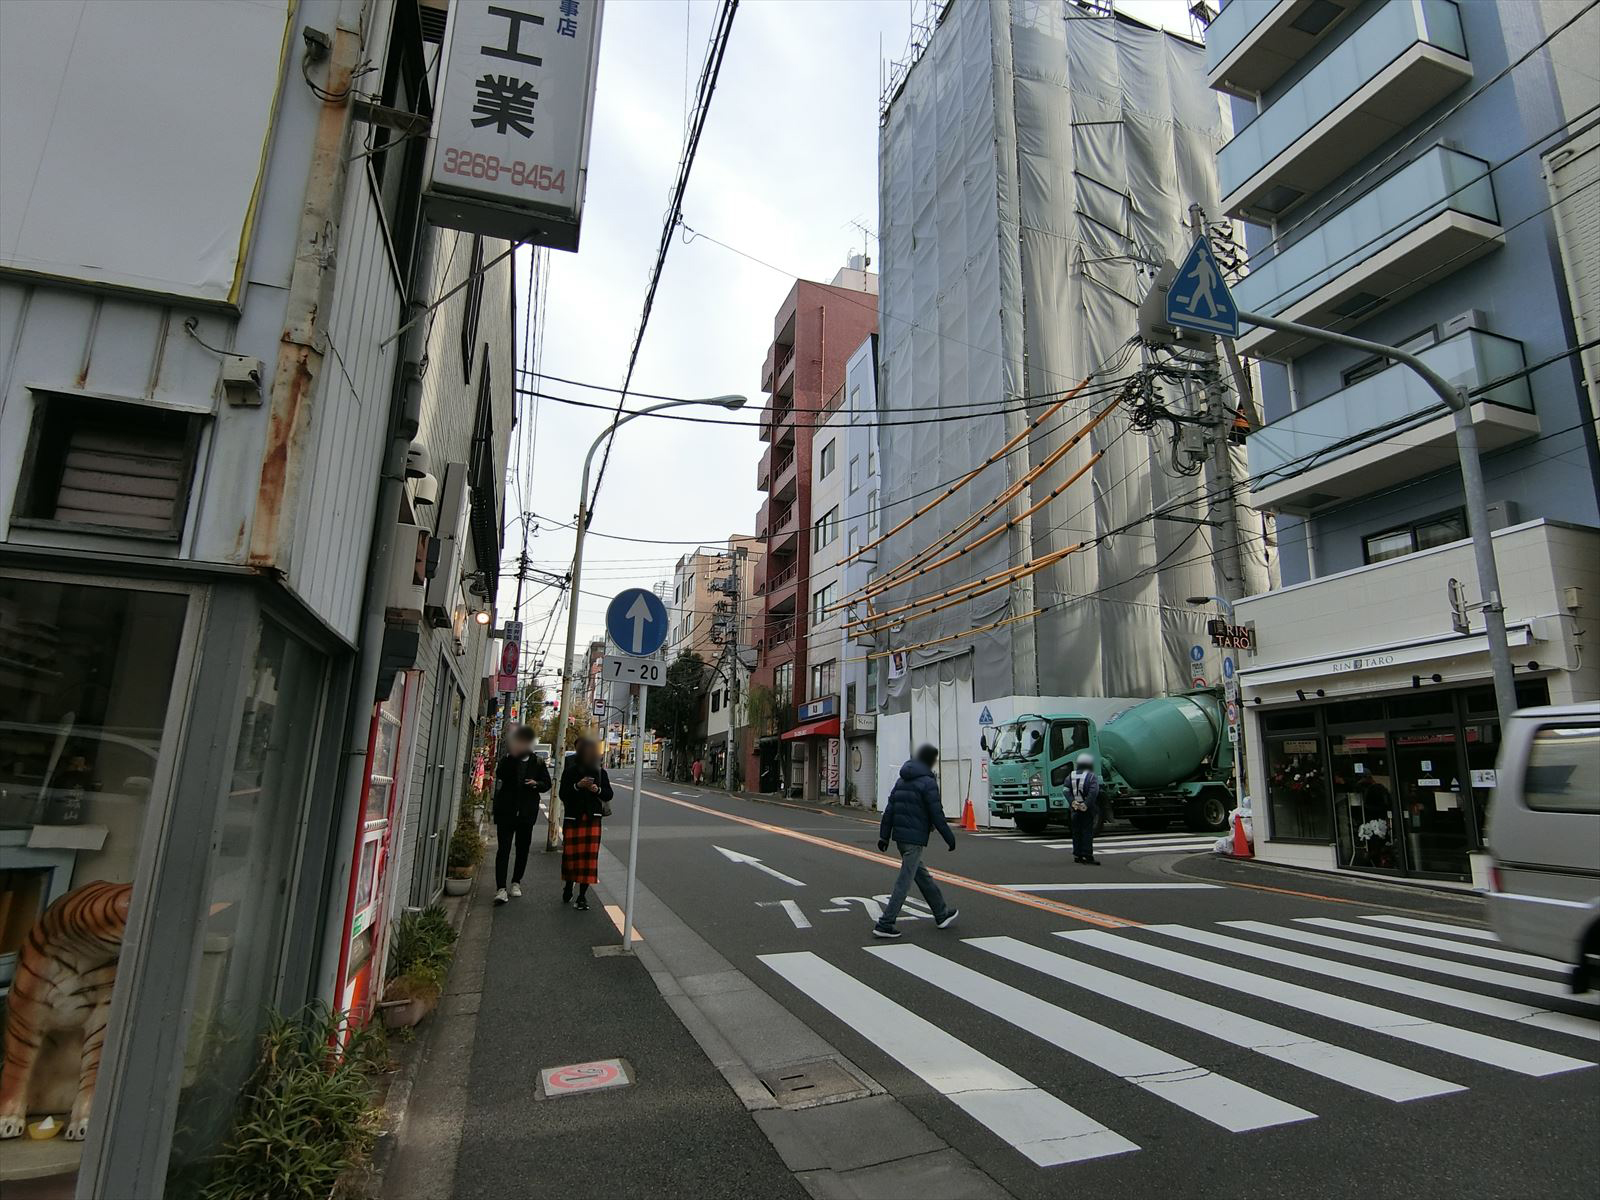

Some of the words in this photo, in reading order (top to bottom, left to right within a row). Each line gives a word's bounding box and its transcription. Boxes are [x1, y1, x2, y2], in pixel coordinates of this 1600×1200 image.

[471, 5, 545, 139] 工業
[443, 147, 566, 194] 3268-8454
[1226, 624, 1249, 637] RIN
[1215, 635, 1250, 649] TARO
[613, 661, 659, 681] 7-20
[1332, 662, 1352, 672] RIN
[1364, 655, 1394, 667] TARO
[830, 740, 839, 788] クリーニング
